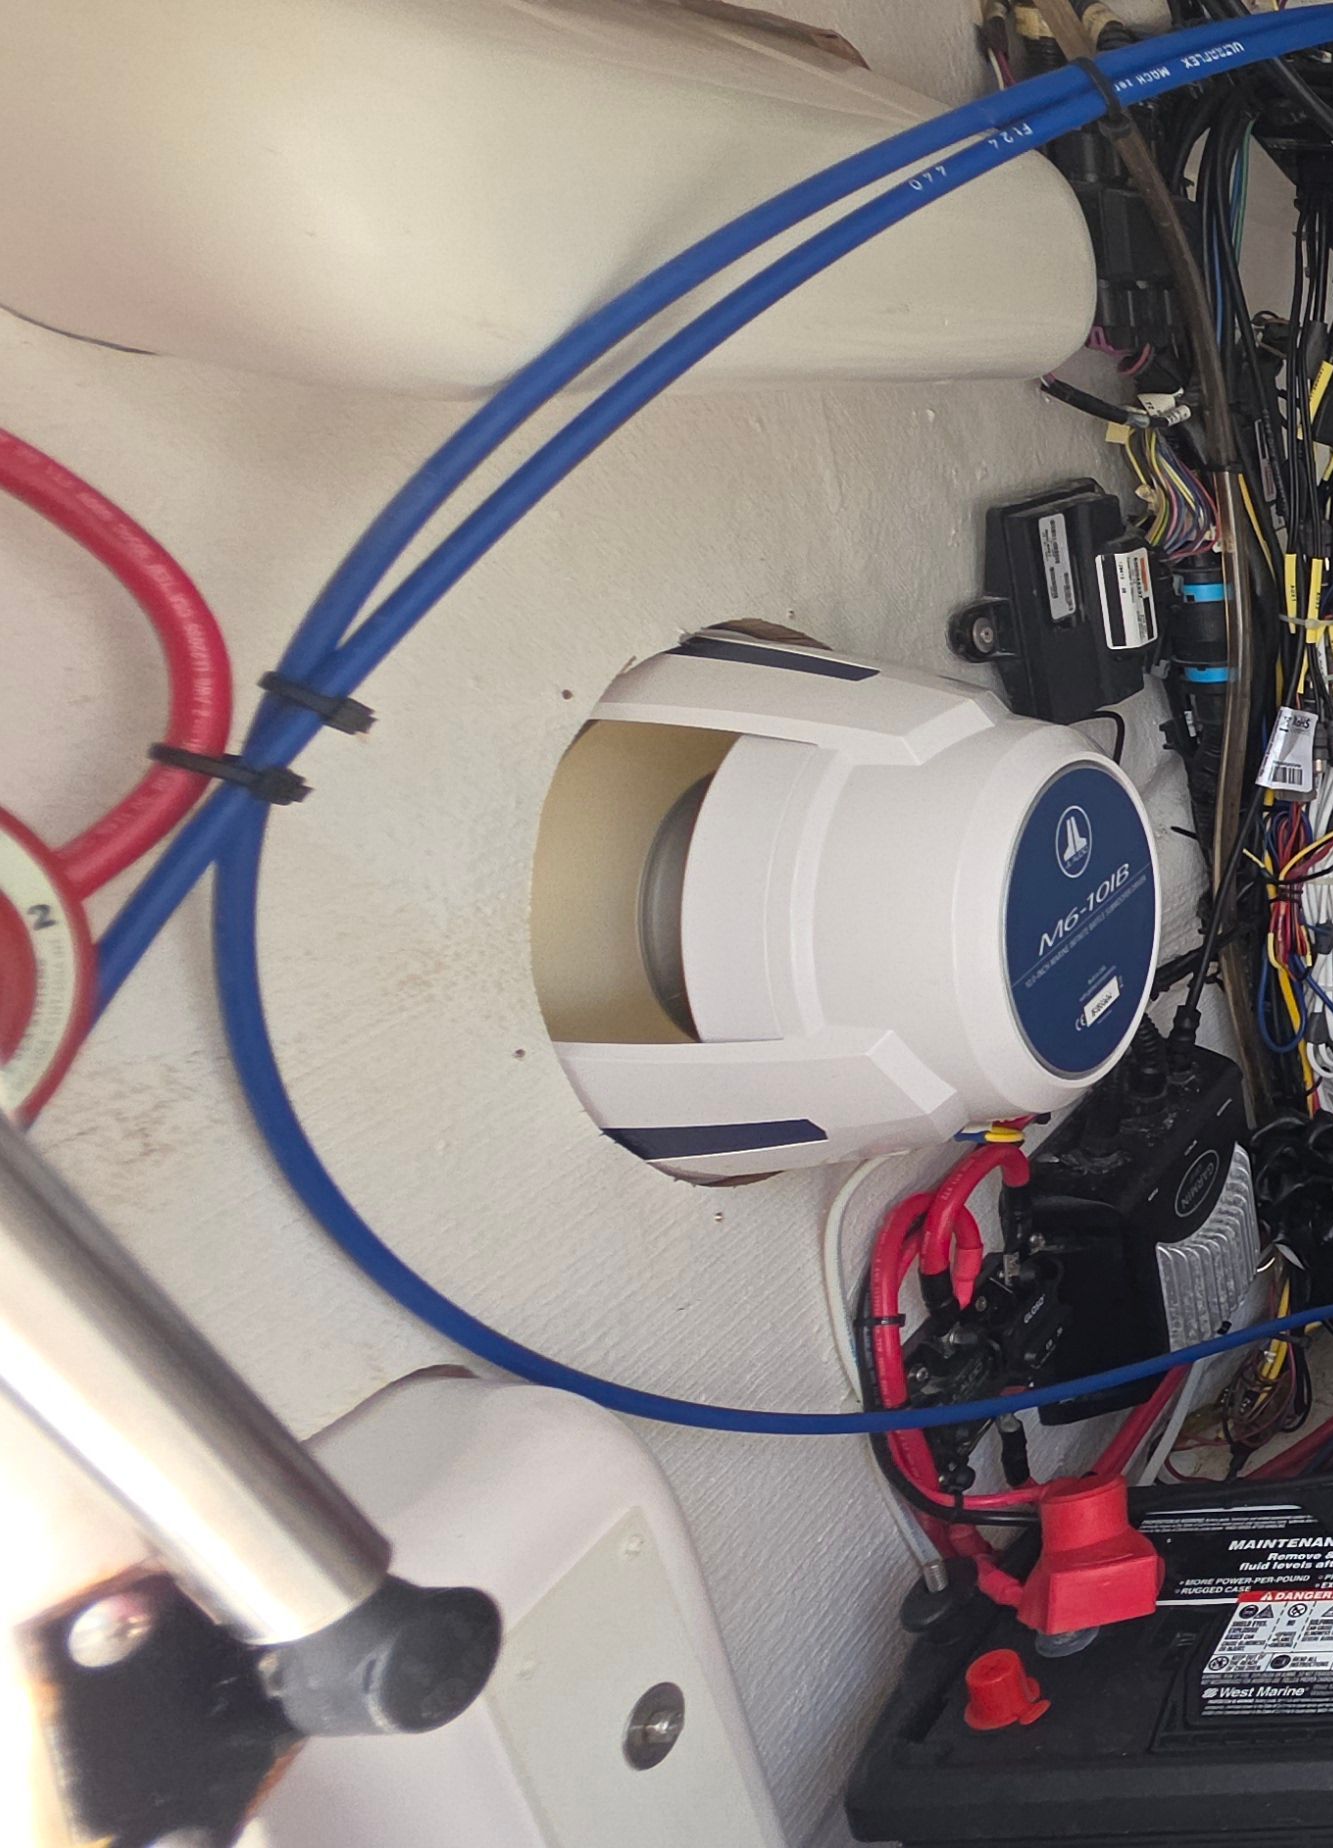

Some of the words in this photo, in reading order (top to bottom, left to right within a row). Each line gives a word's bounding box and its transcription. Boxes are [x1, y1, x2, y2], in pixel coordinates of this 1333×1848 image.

[1181, 42, 1245, 70] ULTRAFLEX
[1137, 66, 1172, 87] MACH
[1038, 863, 1131, 957] M6-10IB
[27, 904, 58, 931] 2
[1267, 1552, 1322, 1561] Remove
[1239, 1561, 1270, 1571] fluid
[1271, 1559, 1313, 1570] levels
[1185, 1577, 1216, 1586] MORE
[1181, 1586, 1223, 1595] RUGGED
[1224, 1585, 1252, 1593] CASE
[1220, 1686, 1255, 1698] West
[1256, 1685, 1305, 1697] Marine
